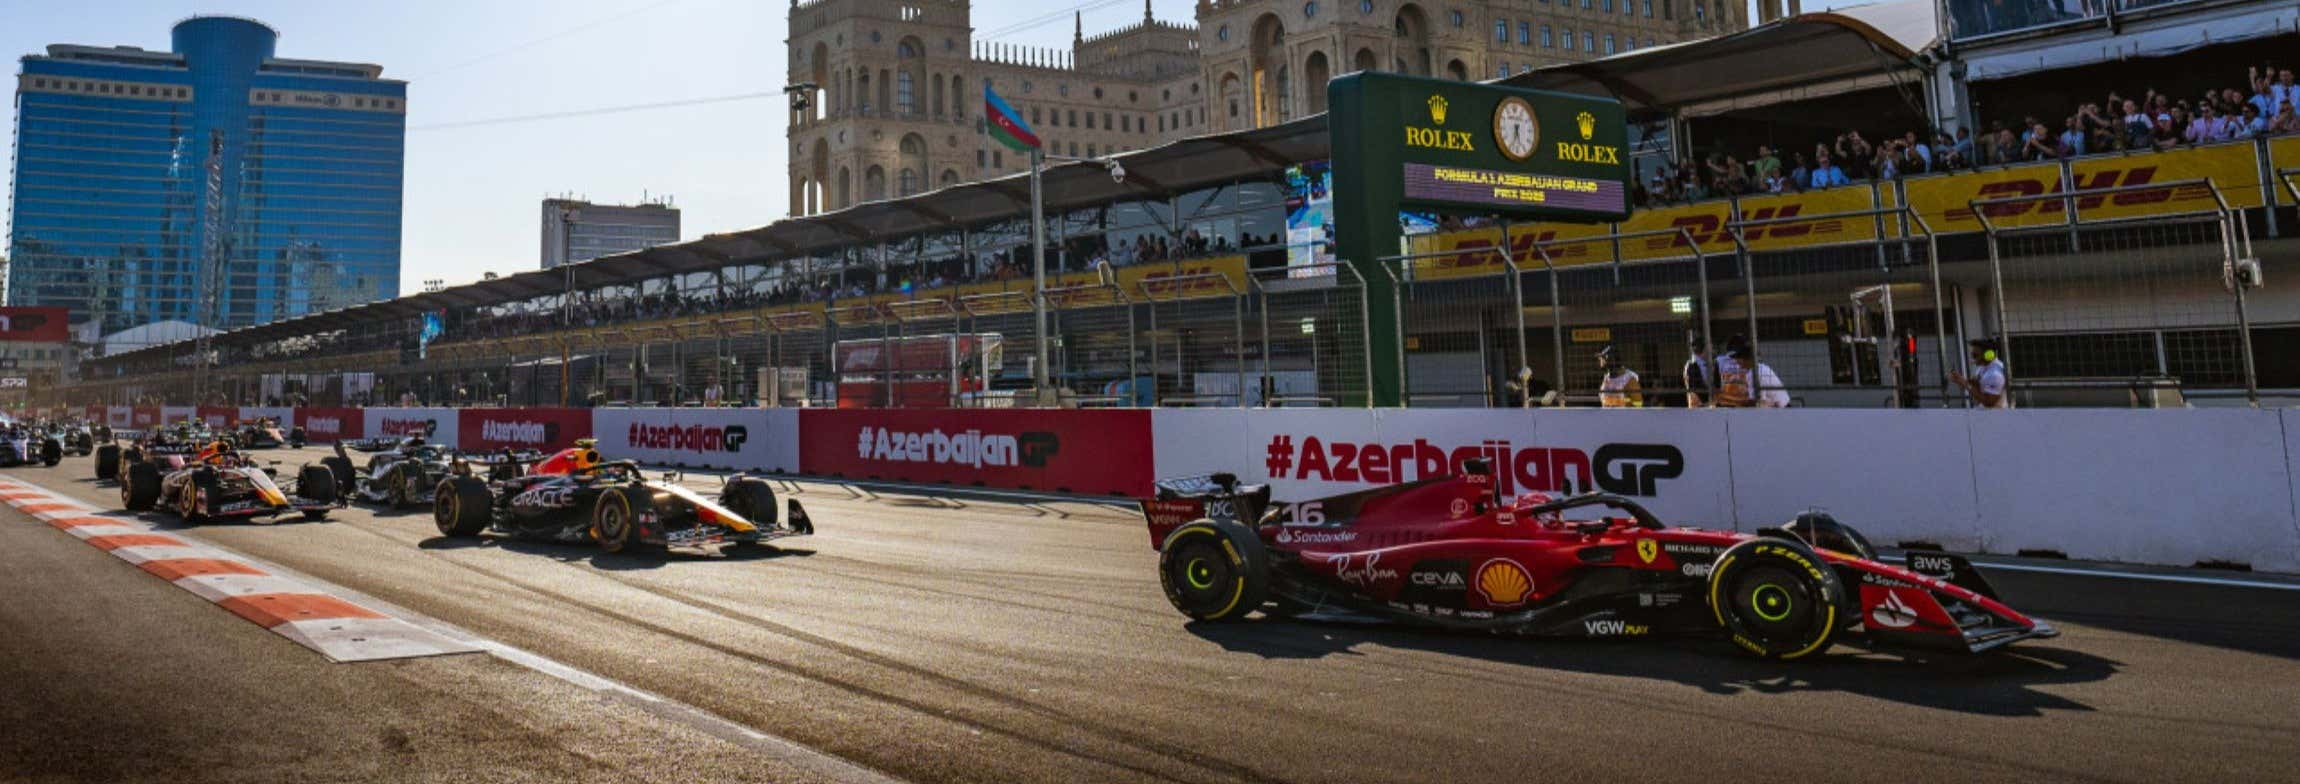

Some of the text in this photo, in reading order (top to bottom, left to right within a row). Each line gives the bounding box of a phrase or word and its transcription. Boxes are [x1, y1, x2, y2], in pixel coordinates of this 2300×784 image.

[1406, 126, 1474, 151] ROLEX
[1557, 142, 1619, 165] ROLEX
[1434, 167, 1598, 193] FORMULA 1 AZERBAIJAN GRAND
[1976, 166, 2174, 217] DHL
[1670, 204, 1813, 247] DHL
[1455, 231, 1564, 267] DHL
[629, 422, 747, 453] #AzerbaijanGP
[858, 426, 1060, 469] #AzerbaijanGP
[1266, 435, 1684, 497] #AzerbaijanGP
[512, 487, 575, 508] ORACLE
[1282, 502, 1326, 526] 16
[1294, 530, 1358, 543] Santander
[1665, 544, 1711, 554] RICHARD
[1914, 556, 1952, 571] aws
[1585, 621, 1625, 635] VGW
